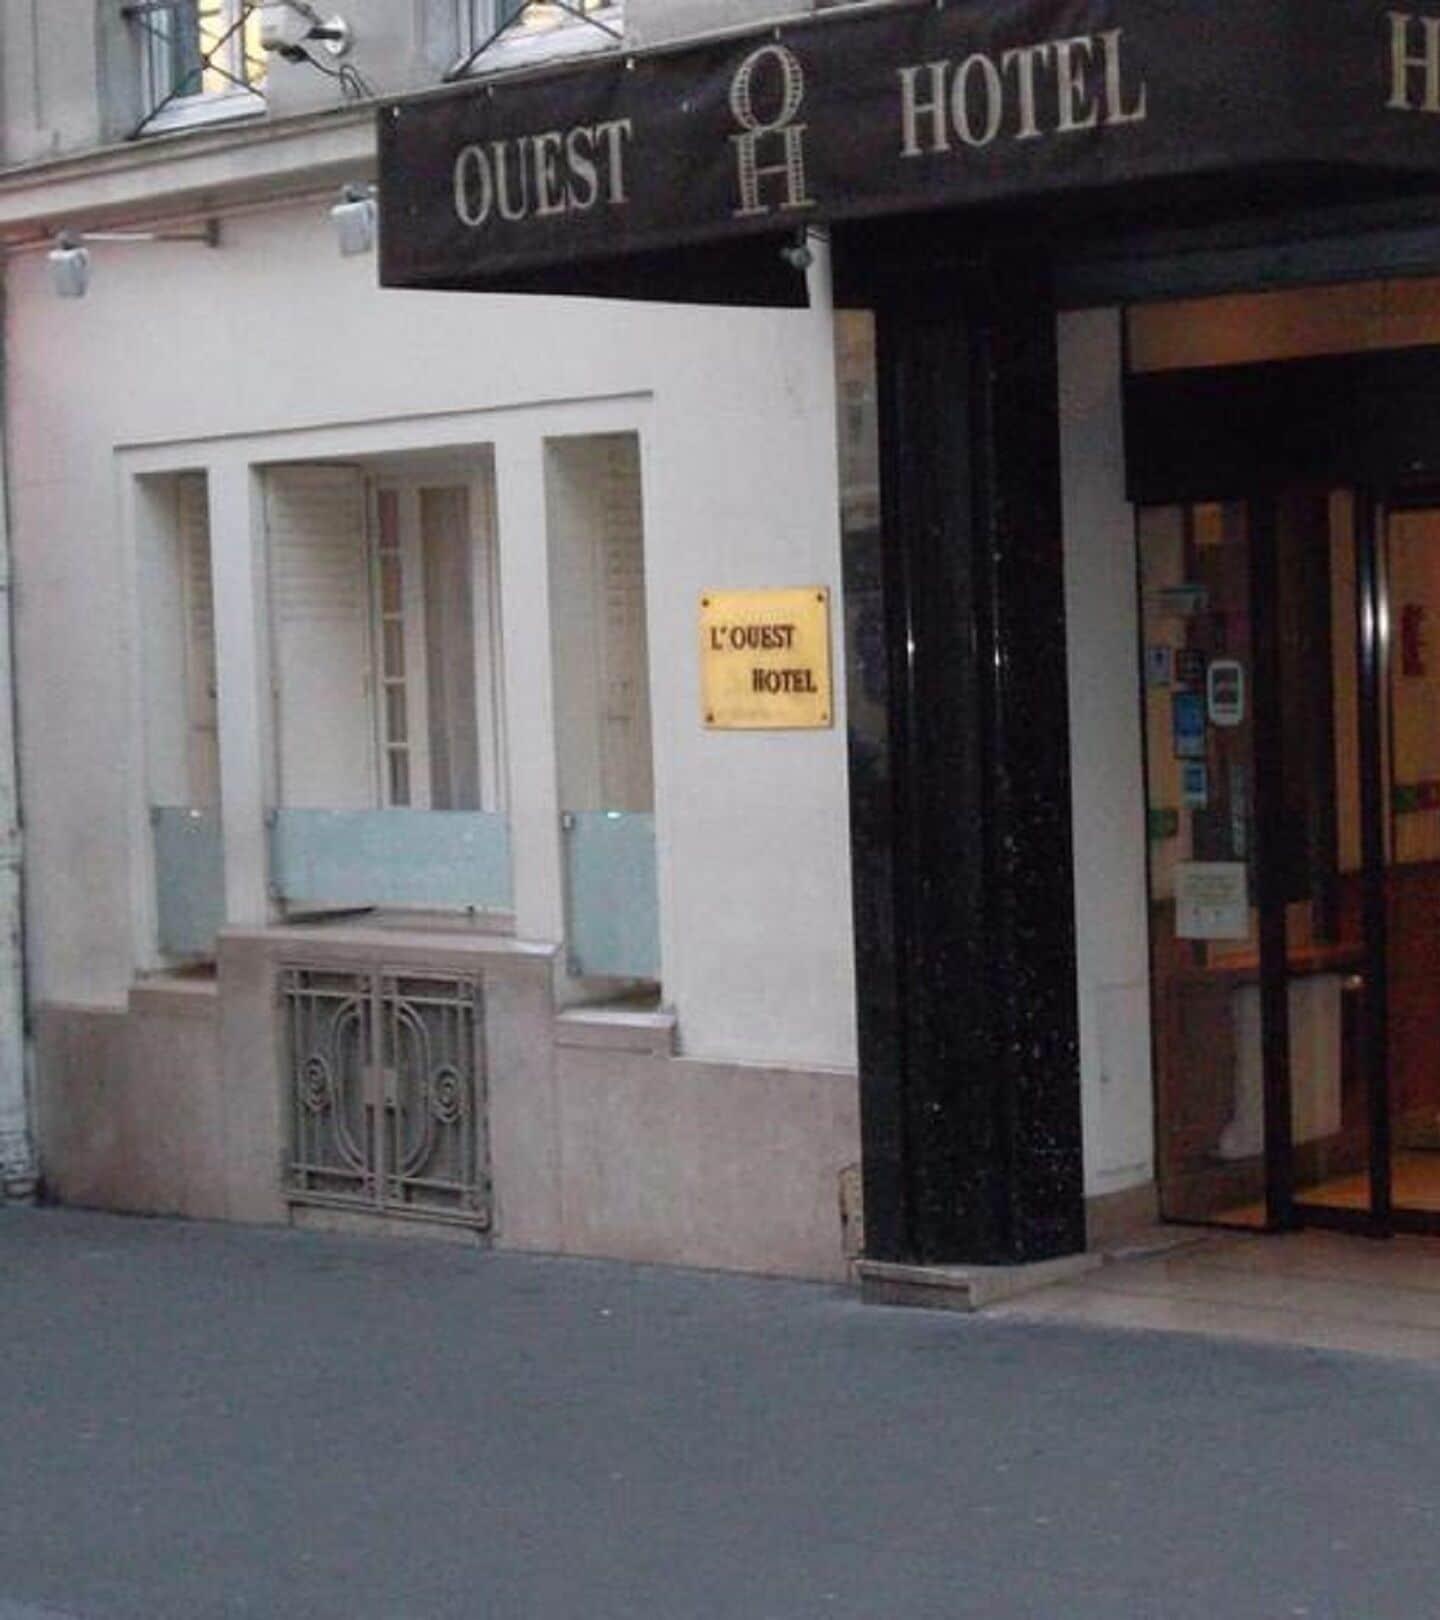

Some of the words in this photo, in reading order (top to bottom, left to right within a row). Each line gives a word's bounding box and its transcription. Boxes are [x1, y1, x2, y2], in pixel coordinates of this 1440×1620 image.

[454, 119, 632, 227] OUEST
[900, 30, 1147, 157] HOTEL
[711, 624, 795, 650] L'OUEST
[752, 668, 818, 694] HOTEL
